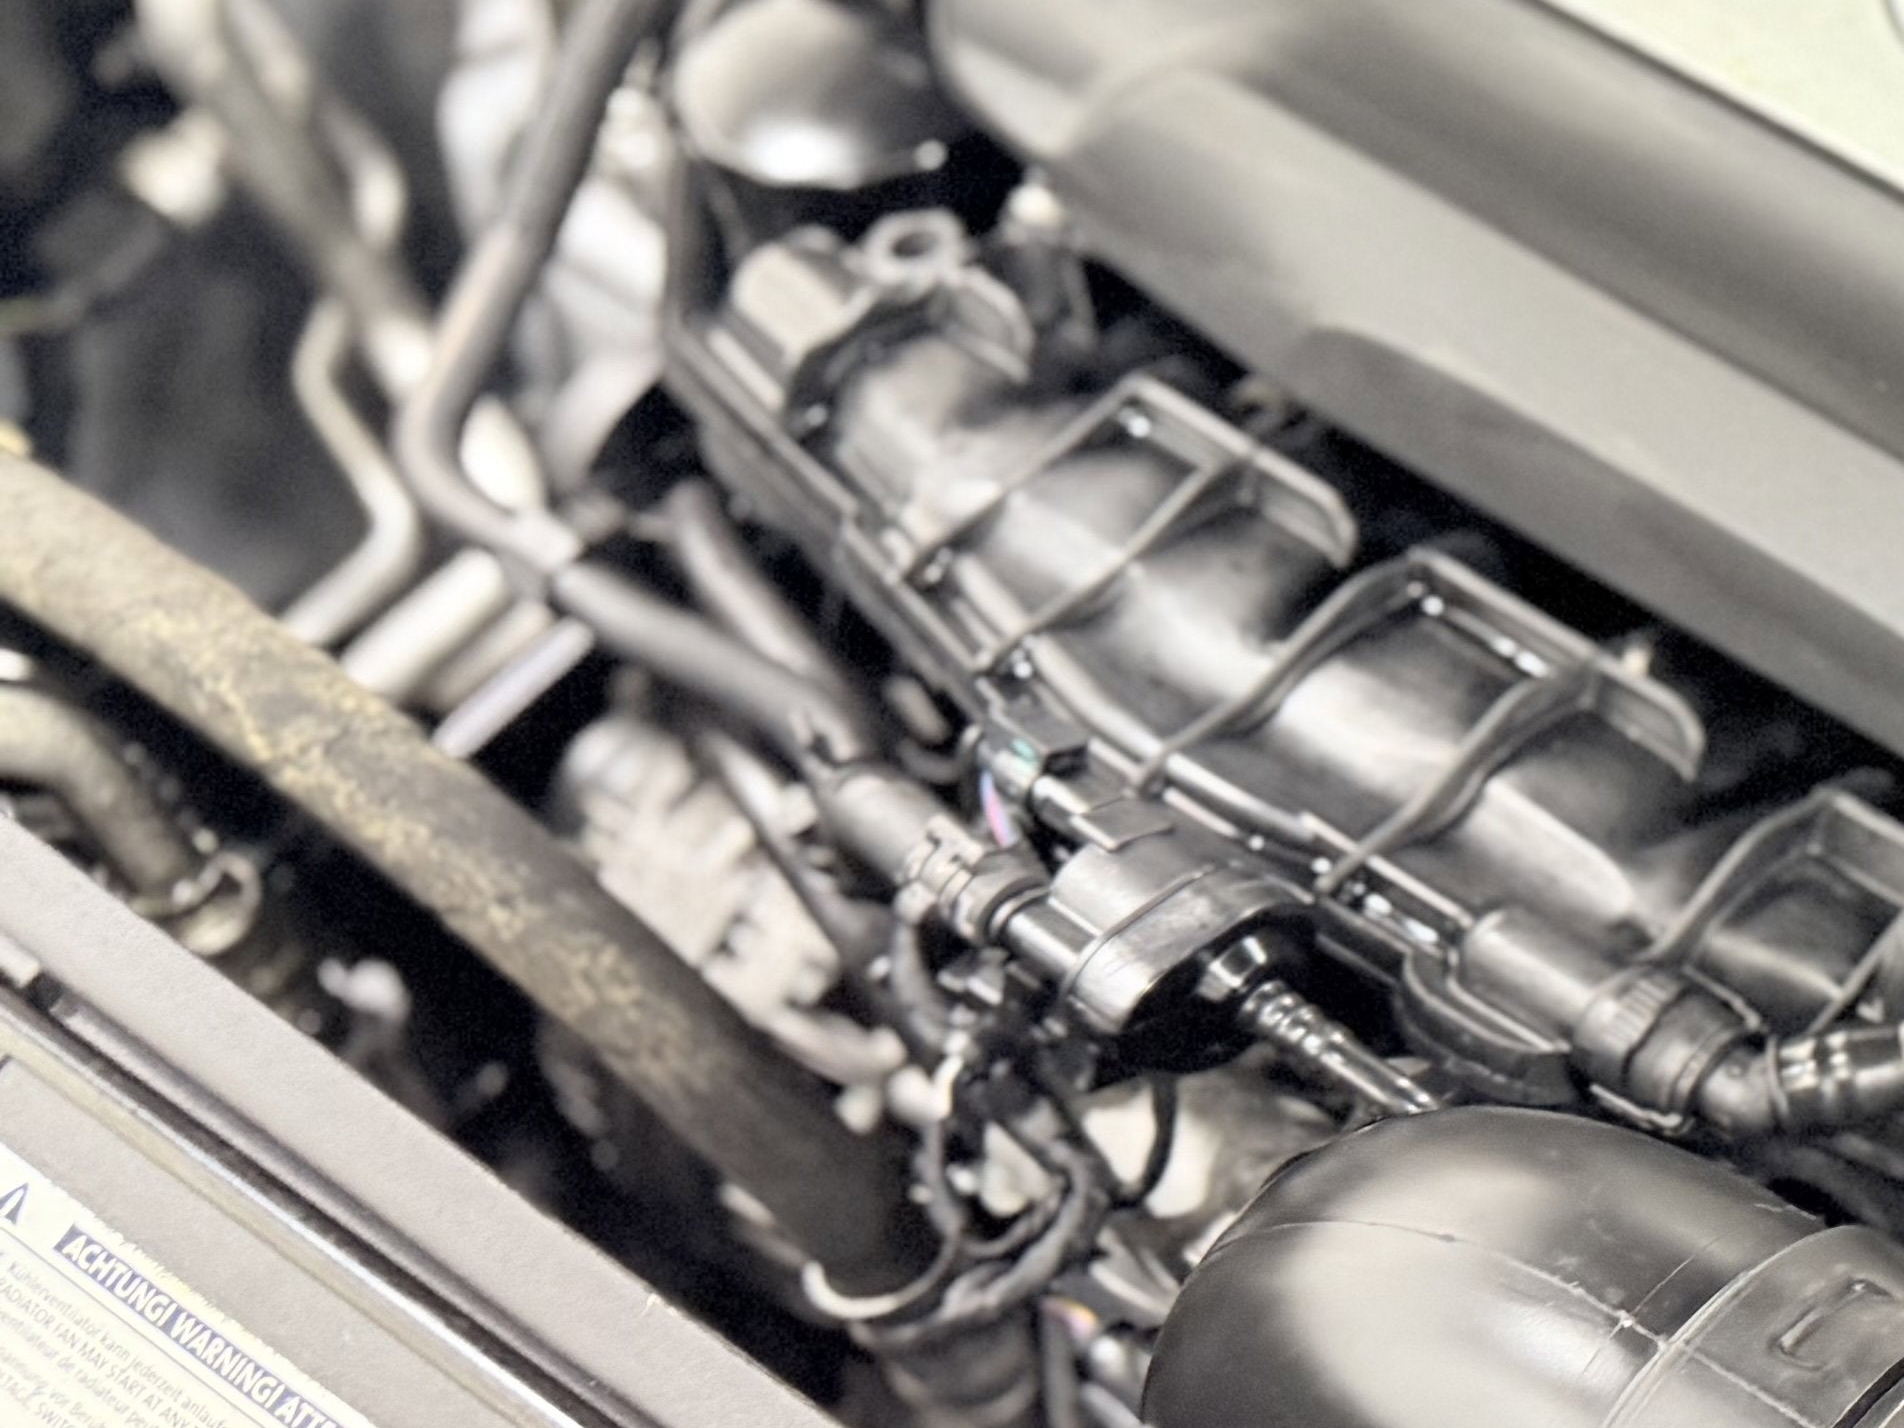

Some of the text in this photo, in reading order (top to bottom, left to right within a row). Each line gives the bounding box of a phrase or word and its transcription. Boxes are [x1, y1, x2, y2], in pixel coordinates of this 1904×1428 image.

[50, 1320, 81, 1350] FAN
[76, 1339, 109, 1372] MAY
[104, 1362, 146, 1401] START
[140, 1389, 162, 1413] AT
[72, 1365, 132, 1417] radiateur
[97, 1329, 133, 1364] kann
[123, 1352, 184, 1408] jederzeit
